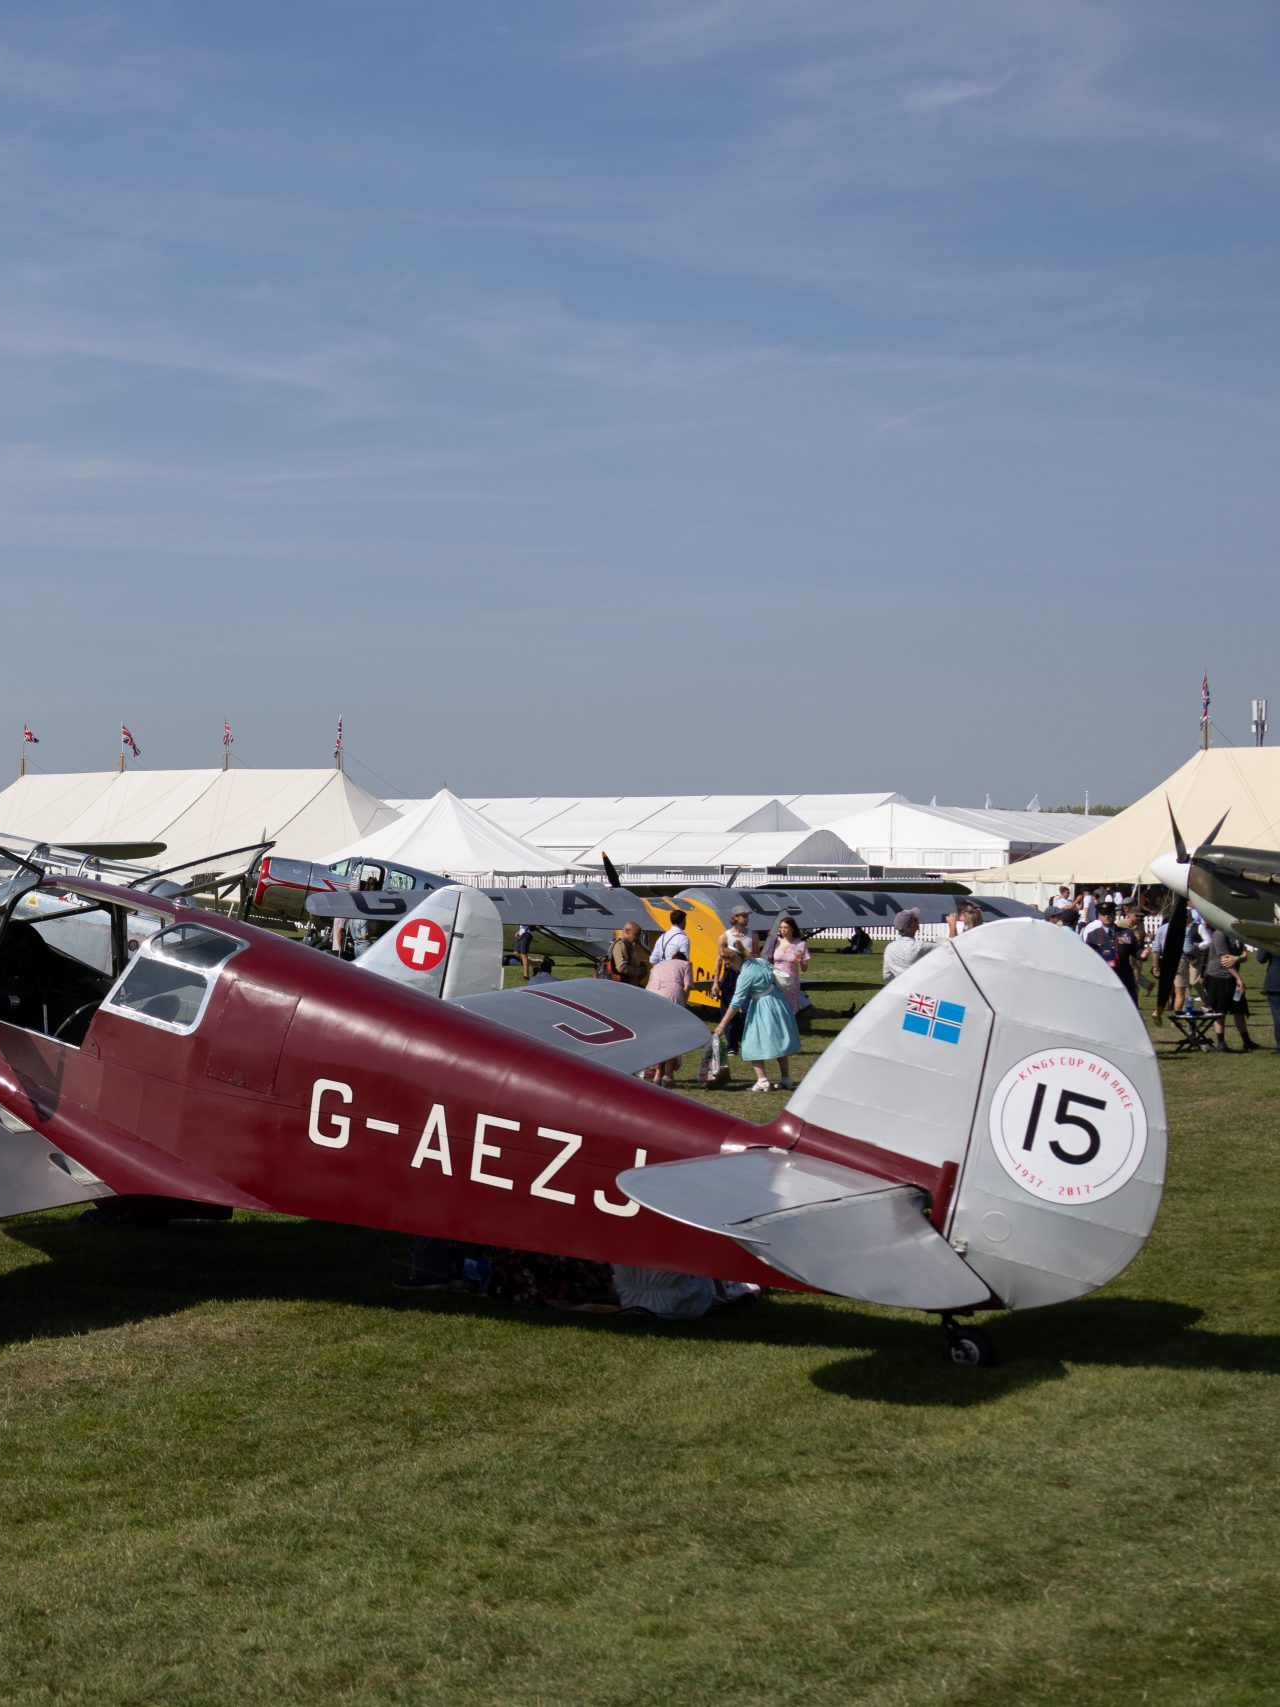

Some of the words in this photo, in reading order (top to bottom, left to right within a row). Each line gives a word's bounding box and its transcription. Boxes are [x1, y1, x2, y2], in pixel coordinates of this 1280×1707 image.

[1018, 1057, 1056, 1081] KINGS
[1060, 1056, 1084, 1068] CUP
[1087, 1063, 1110, 1080] AIR
[1110, 1080, 1135, 1110] RACE
[308, 1078, 648, 1218] G-AEZJ
[1022, 1082, 1108, 1166] 15
[1014, 1163, 1044, 1188] 1937
[1058, 1184, 1091, 1196] 2017
